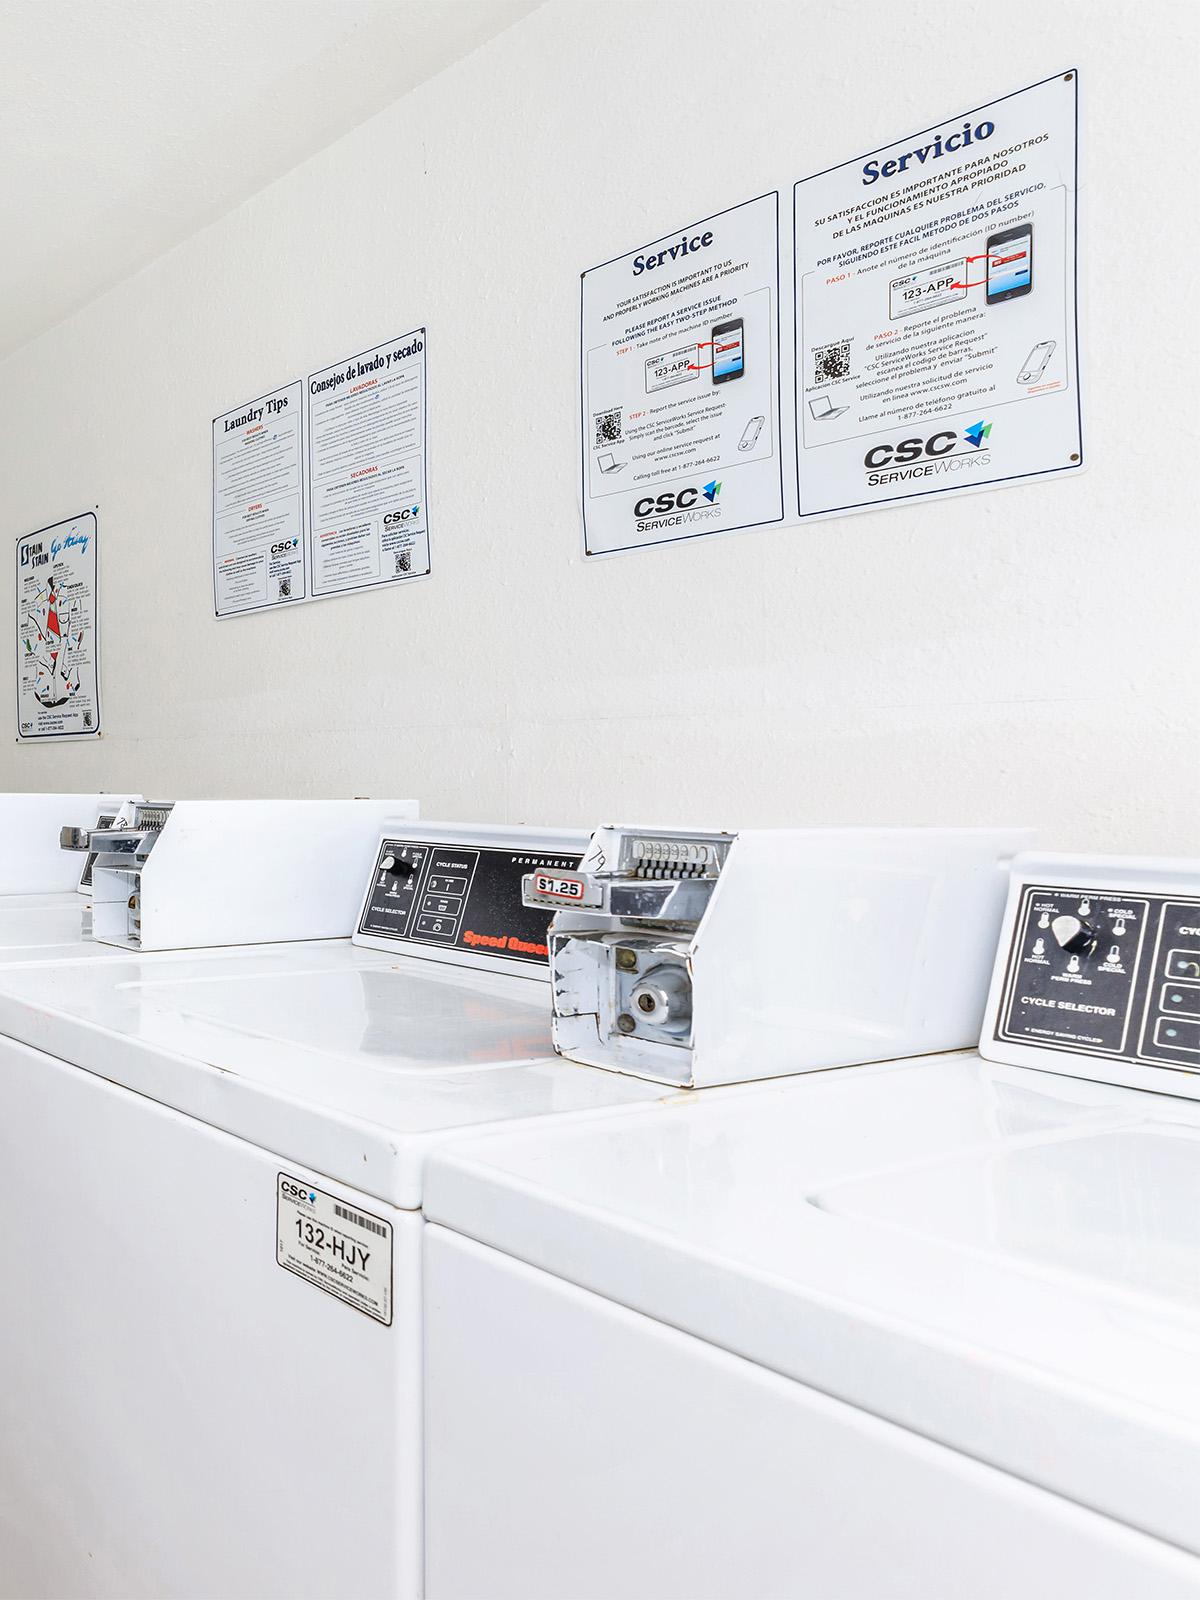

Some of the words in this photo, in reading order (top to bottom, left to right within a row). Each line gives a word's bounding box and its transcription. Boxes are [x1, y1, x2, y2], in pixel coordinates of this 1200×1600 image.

[863, 122, 994, 185] Servicio
[814, 217, 826, 227] SU
[827, 195, 889, 223] SATISFACCION
[890, 189, 901, 200] ES
[902, 166, 962, 194] IMPORTANTE
[964, 156, 991, 171] PARA
[993, 133, 1049, 160] NOSOTROS
[847, 216, 853, 224] Y
[854, 213, 865, 222] EL
[866, 182, 948, 217] FUNCIONAMIENTO
[950, 160, 1008, 187] APROPIADO
[832, 229, 844, 240] DE
[845, 223, 862, 235] LAS
[863, 205, 912, 228] MAQUINAS
[913, 200, 924, 211] ES
[925, 185, 969, 206] NUESTRA
[971, 163, 1026, 189] PRIORIDAD
[816, 257, 832, 267] POR
[860, 235, 893, 252] REPORTE
[894, 219, 939, 240] CUALQUIER
[940, 204, 985, 224] PROBLEMA
[986, 197, 1003, 209] DEL
[826, 274, 846, 285] PASO
[856, 264, 879, 275] Anote
[879, 260, 887, 268] el
[918, 247, 929, 255] de
[984, 223, 997, 233] (ID
[998, 210, 1035, 228] number)
[838, 249, 879, 268] SIGUIENDO
[880, 242, 898, 254] ESTE
[922, 222, 958, 239] METODO
[958, 217, 970, 227] DE
[971, 210, 989, 223] DOS
[990, 200, 1019, 216] PASOS
[633, 232, 713, 276] Service
[897, 262, 908, 270] de
[602, 313, 615, 322] AND
[614, 302, 642, 317] PROPERLY
[642, 291, 670, 307] WORKING
[670, 279, 701, 296] MACHINES
[701, 274, 714, 285] ARE
[719, 262, 749, 278] PRIORITY
[616, 298, 632, 309] YOUR
[632, 283, 671, 303] SATISFACTION
[671, 280, 678, 288] IS
[677, 266, 713, 285] IMPORTANT
[713, 263, 723, 271] TO
[723, 259, 733, 268] US
[890, 277, 911, 289] CSC
[902, 277, 956, 300] 123-APP
[611, 330, 646, 347] FOLLOWING
[646, 325, 658, 334] THE
[658, 319, 675, 330] EASY
[675, 308, 708, 324] TWO-STEP
[708, 297, 738, 312] METHOD
[624, 322, 646, 335] PLEASE
[646, 313, 670, 327] REPORT
[676, 302, 702, 316] SERVICE
[702, 294, 721, 306] ISSUE
[873, 330, 893, 341] PASO
[903, 320, 932, 332] Reporte
[932, 316, 940, 324] el
[940, 307, 977, 323] problema
[310, 373, 345, 395] Consejos
[345, 365, 356, 381] de
[357, 354, 385, 377] lavado
[385, 353, 392, 370] y
[392, 338, 423, 362] secado
[646, 358, 660, 367] CSC
[654, 359, 691, 377] 123-APP
[349, 378, 378, 394] LAVADORAS
[859, 388, 894, 402] Utilizando
[894, 382, 921, 393] nuestra
[922, 372, 953, 386] solicitud
[953, 370, 964, 378] de
[964, 363, 994, 375] servicio
[910, 378, 968, 396] www.cscsw.com
[224, 407, 264, 433] Laundry
[265, 397, 288, 414] Tips
[858, 413, 879, 423] Llame
[879, 410, 886, 418] al
[956, 387, 988, 401] gratuito
[988, 384, 996, 392] al
[898, 403, 952, 421] 1-877-264-6622
[246, 424, 264, 435] WASHERS
[864, 431, 956, 468] CSC
[350, 465, 378, 479] SECADORAS
[248, 503, 263, 512] DRYERS
[383, 509, 411, 525] CSC
[634, 488, 698, 517] CSC
[270, 540, 292, 554] CSC
[511, 856, 575, 868] PERMANENT
[463, 930, 508, 946] Speed
[1021, 996, 1056, 1008] CYCLE
[1057, 1001, 1116, 1016] SELECTOR
[281, 1181, 308, 1200] CSC
[296, 1219, 370, 1270] 132-HJY
